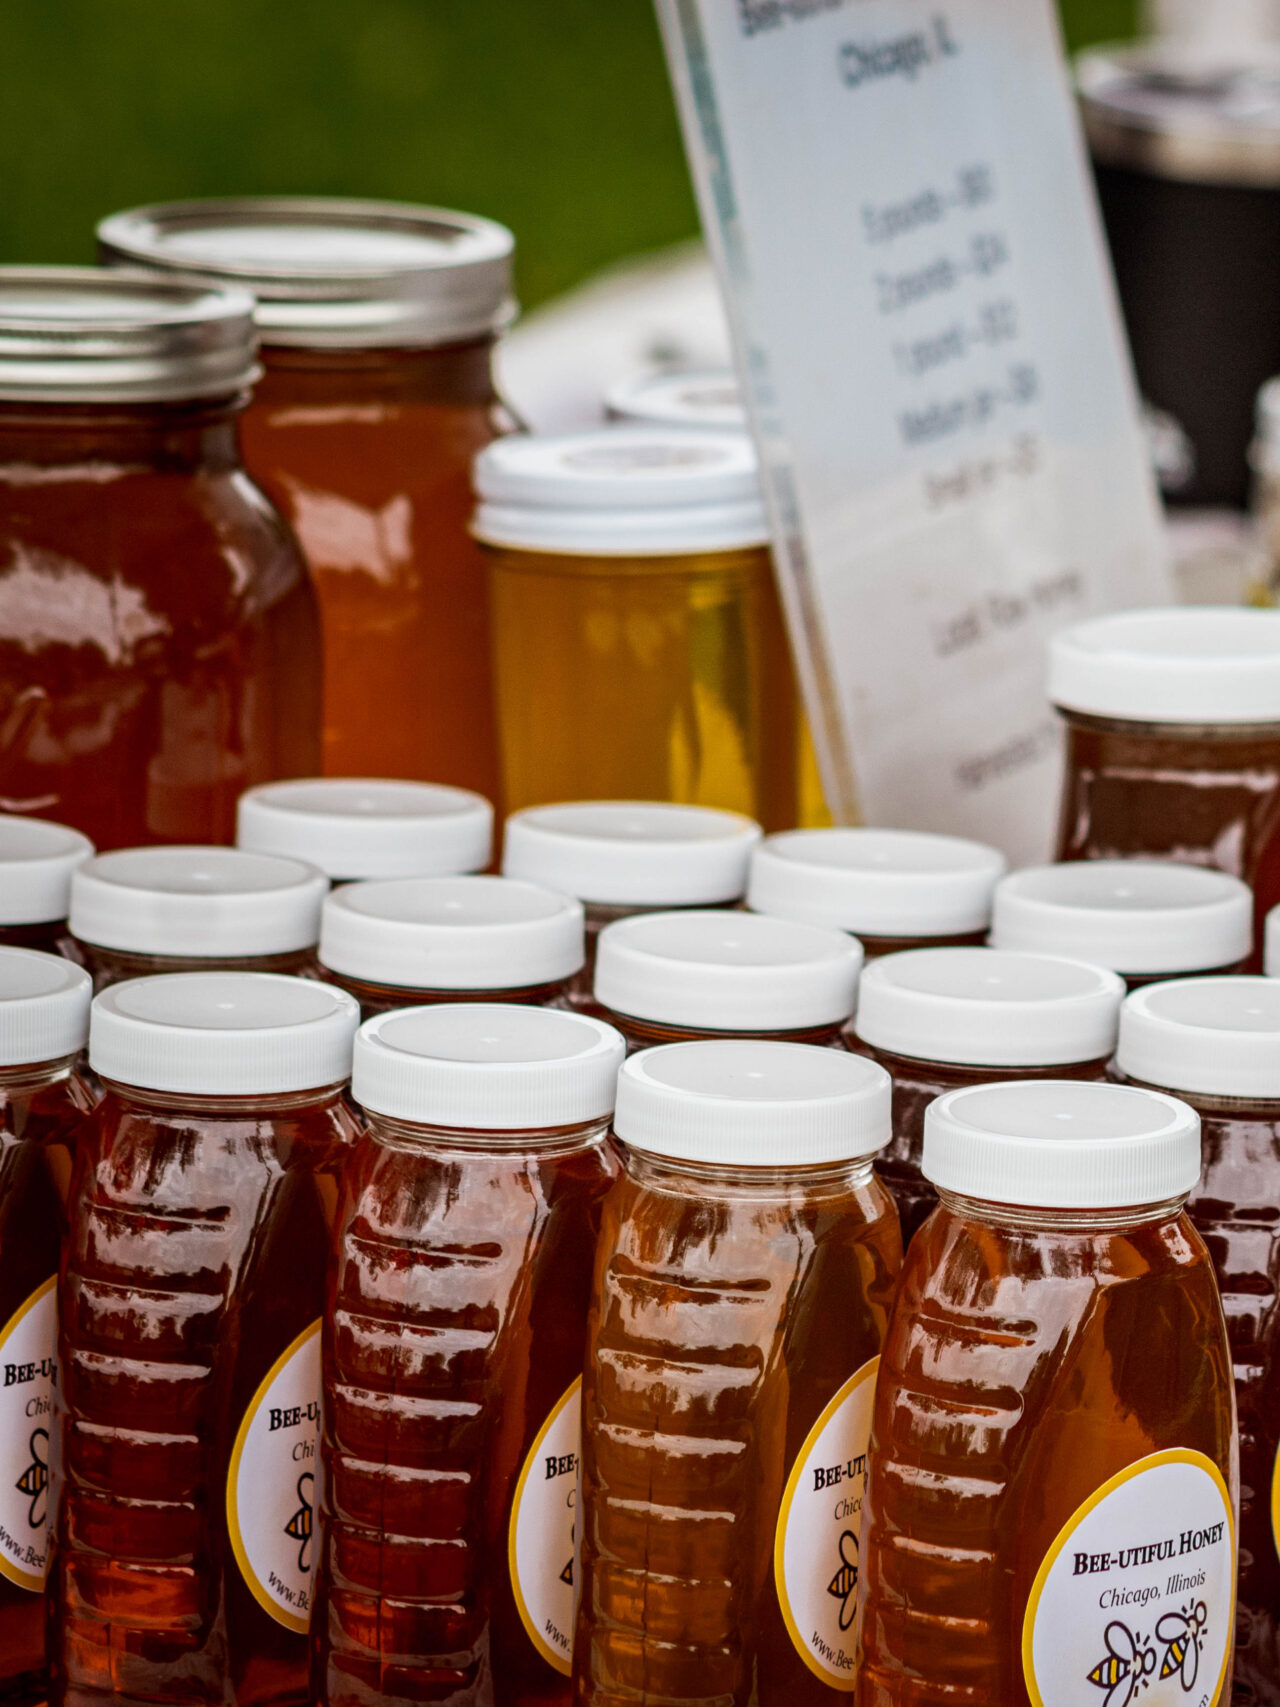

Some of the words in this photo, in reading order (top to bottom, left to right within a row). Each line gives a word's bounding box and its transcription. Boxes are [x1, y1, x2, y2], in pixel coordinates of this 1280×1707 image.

[1072, 1539, 1176, 1576] BEE-UTIFUL
[1178, 1521, 1225, 1555] HONEY
[1099, 1584, 1161, 1609] Chicago,
[1165, 1567, 1206, 1595] Illinois
